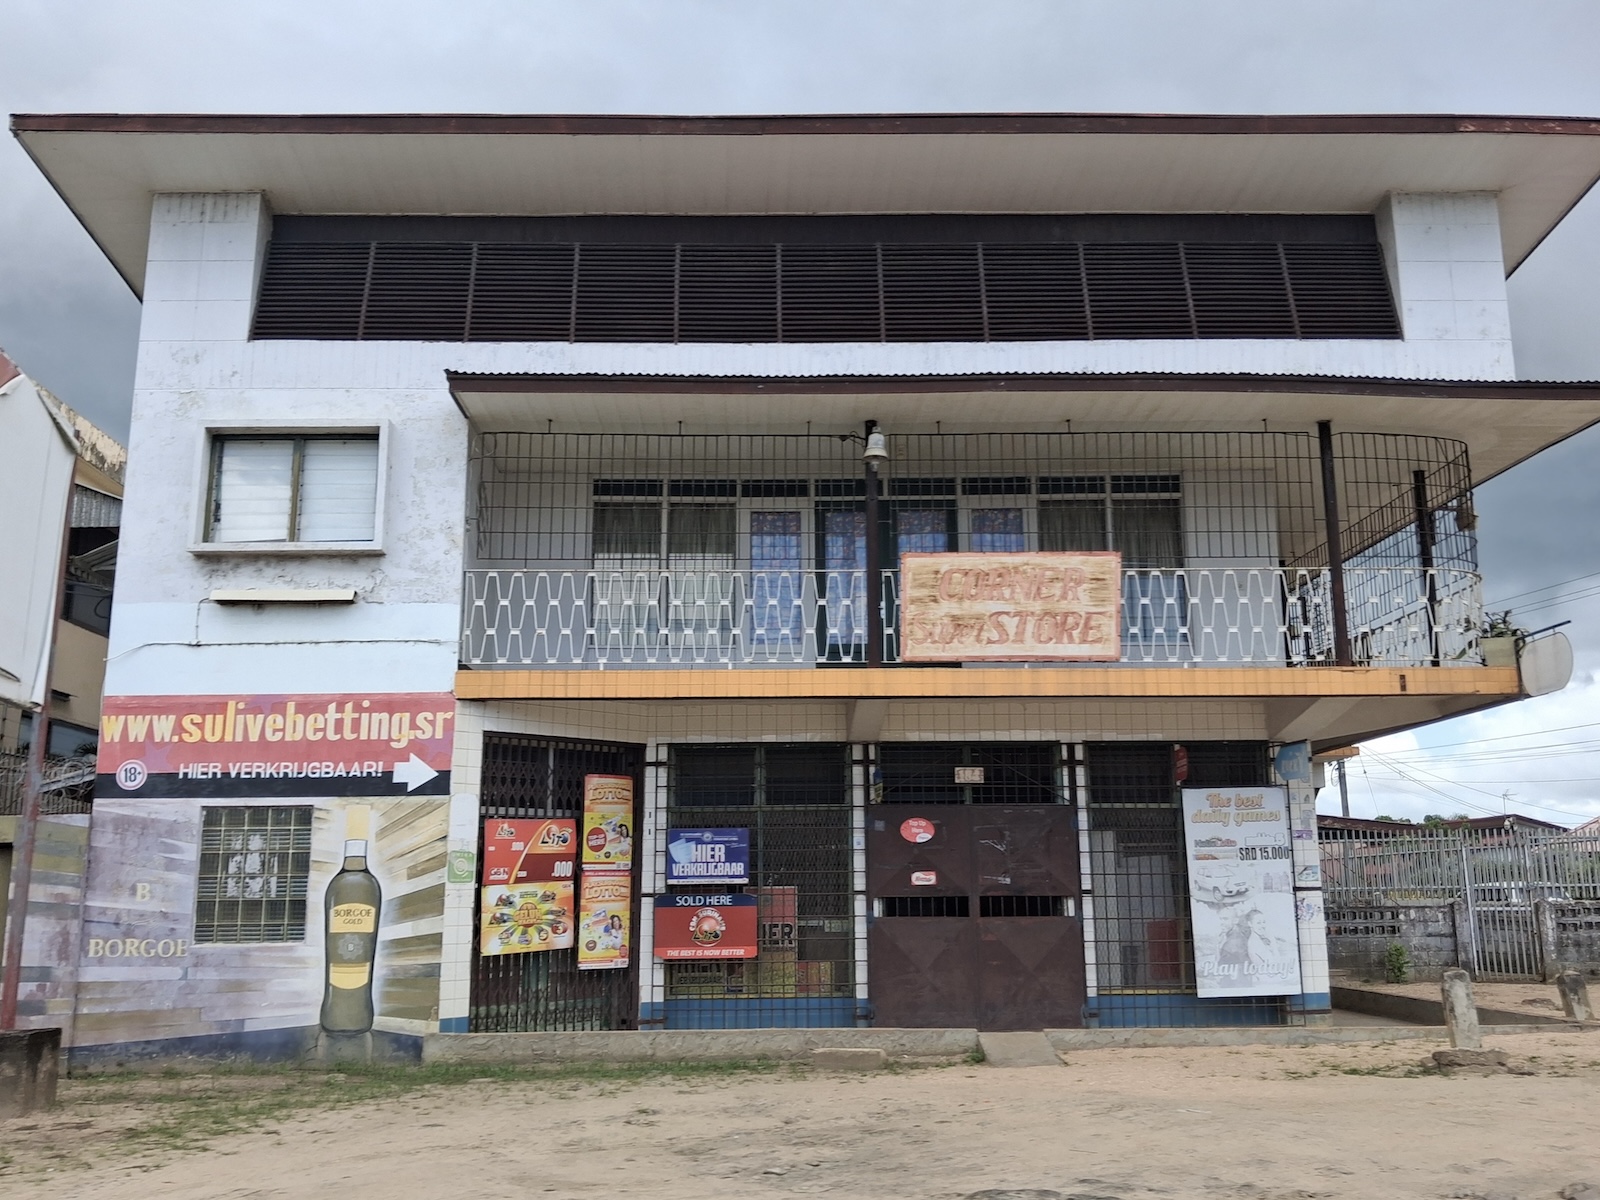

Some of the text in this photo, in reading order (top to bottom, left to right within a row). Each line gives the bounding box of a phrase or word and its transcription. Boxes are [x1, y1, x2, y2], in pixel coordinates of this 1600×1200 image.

[939, 566, 1086, 602] CORNER
[986, 610, 1110, 645] STORE
[101, 700, 454, 748] www.sulivebetting.sr
[178, 762, 222, 780] HIER
[1205, 792, 1264, 809] The best
[1191, 809, 1281, 827] daily games
[690, 843, 726, 863] HIER
[1238, 847, 1257, 862] SRD
[135, 882, 151, 902] B
[675, 895, 733, 907] SOLD HERE
[333, 908, 373, 918] BORGOE
[762, 922, 796, 947] IER
[88, 938, 188, 958] BORGOE
[721, 948, 745, 956] BETTER
[1202, 958, 1296, 980] Play today!
